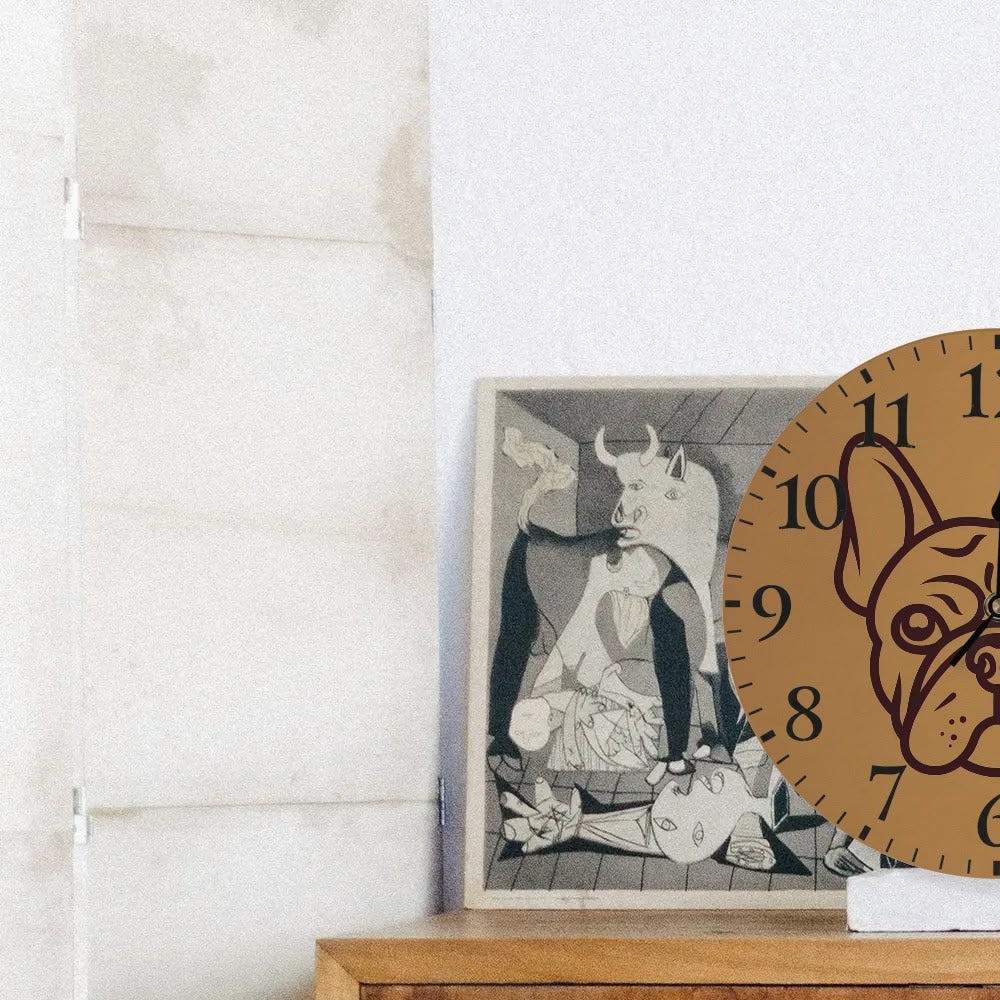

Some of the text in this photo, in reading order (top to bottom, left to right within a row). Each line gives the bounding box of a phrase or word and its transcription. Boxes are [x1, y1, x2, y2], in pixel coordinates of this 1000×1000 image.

[854, 393, 916, 450] 11
[775, 473, 847, 530] 10
[752, 584, 792, 642] 9
[786, 685, 823, 742] 8
[869, 764, 906, 821] 7
